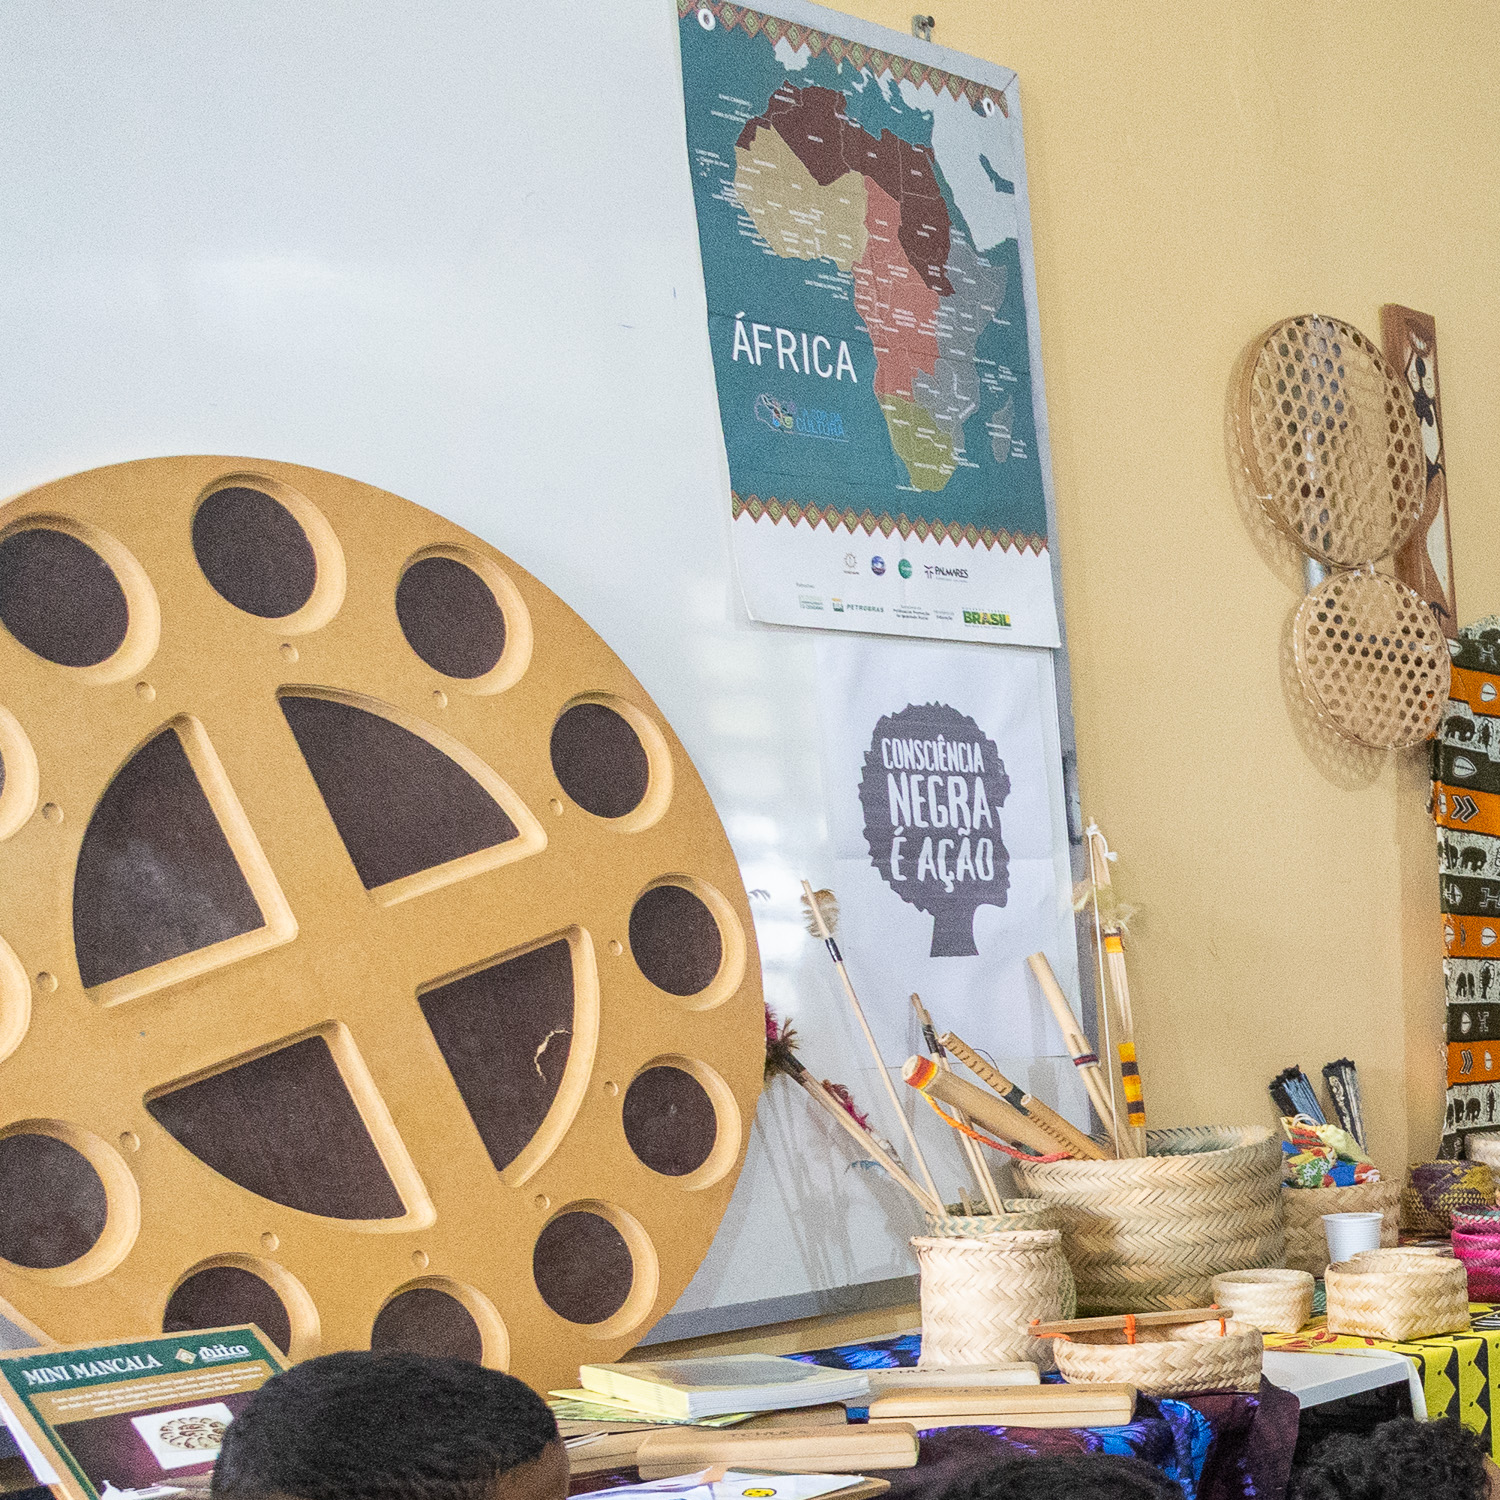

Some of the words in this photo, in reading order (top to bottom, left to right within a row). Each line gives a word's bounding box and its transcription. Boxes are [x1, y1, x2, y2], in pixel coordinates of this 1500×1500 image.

[732, 311, 858, 383] ÁFRICA
[934, 565, 969, 579] PALMARES
[846, 603, 884, 613] PETROBRAS
[962, 610, 1012, 628] BRASIL
[881, 735, 985, 773] CONSCIÊNCIA
[887, 772, 994, 830] NEGRA
[891, 828, 908, 882] É
[917, 826, 995, 894] AÇÃO
[21, 1363, 71, 1387] MINI
[68, 1353, 164, 1380] MANCALA
